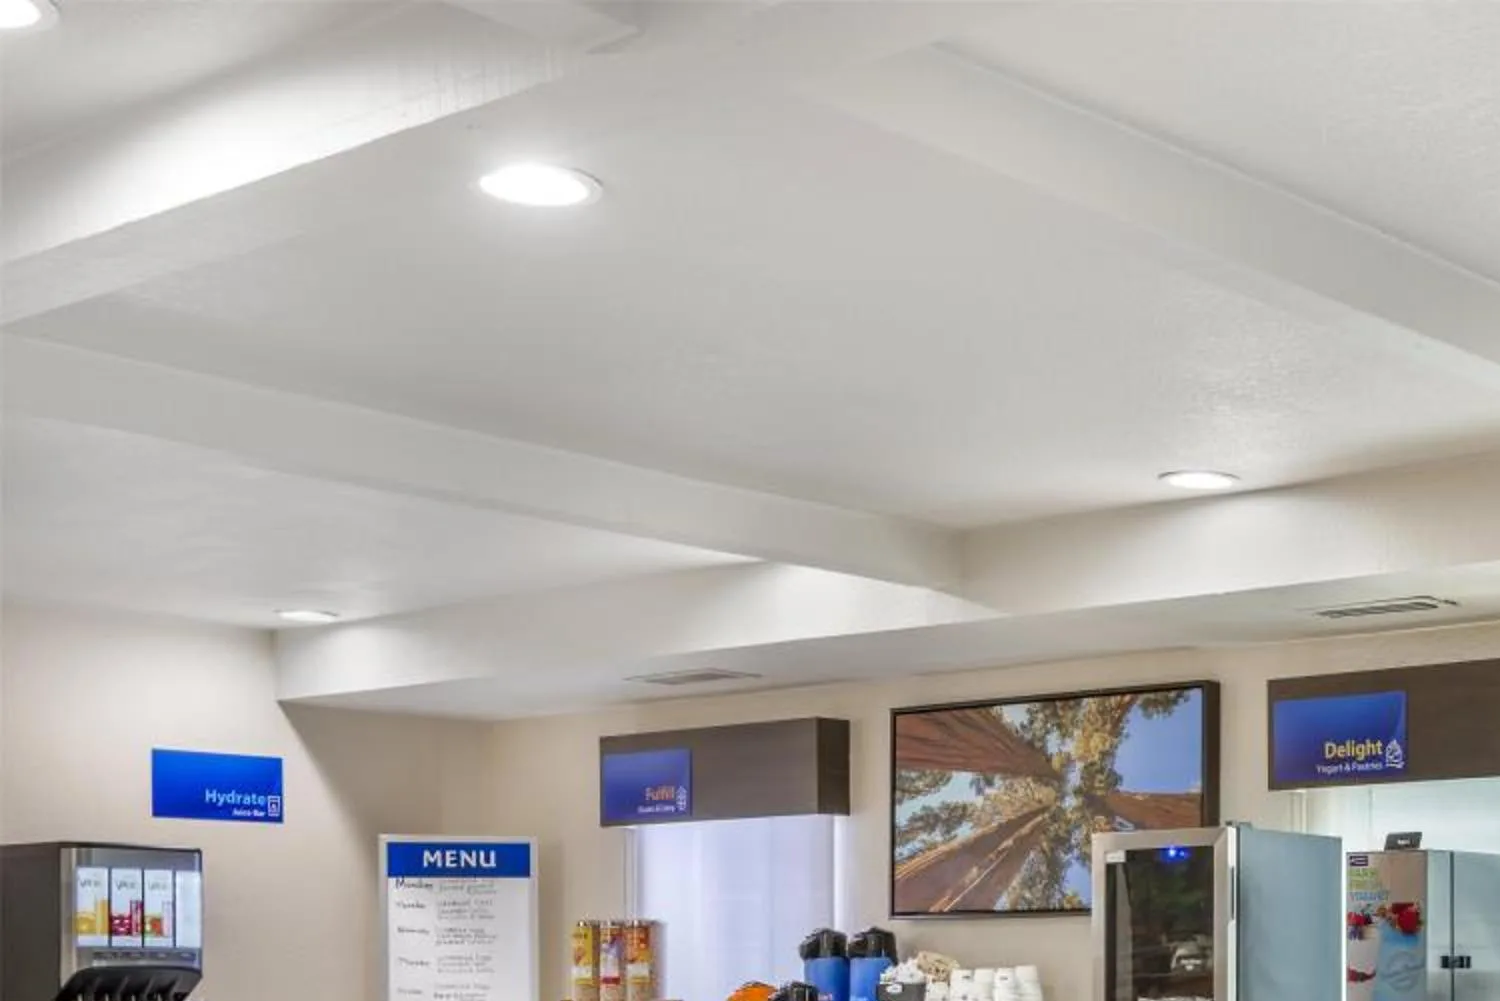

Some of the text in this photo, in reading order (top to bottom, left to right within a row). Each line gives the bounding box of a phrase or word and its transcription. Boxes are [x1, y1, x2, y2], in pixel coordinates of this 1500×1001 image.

[1325, 739, 1383, 761] Delight
[205, 788, 266, 807] Hydrate
[422, 849, 497, 868] MENU
